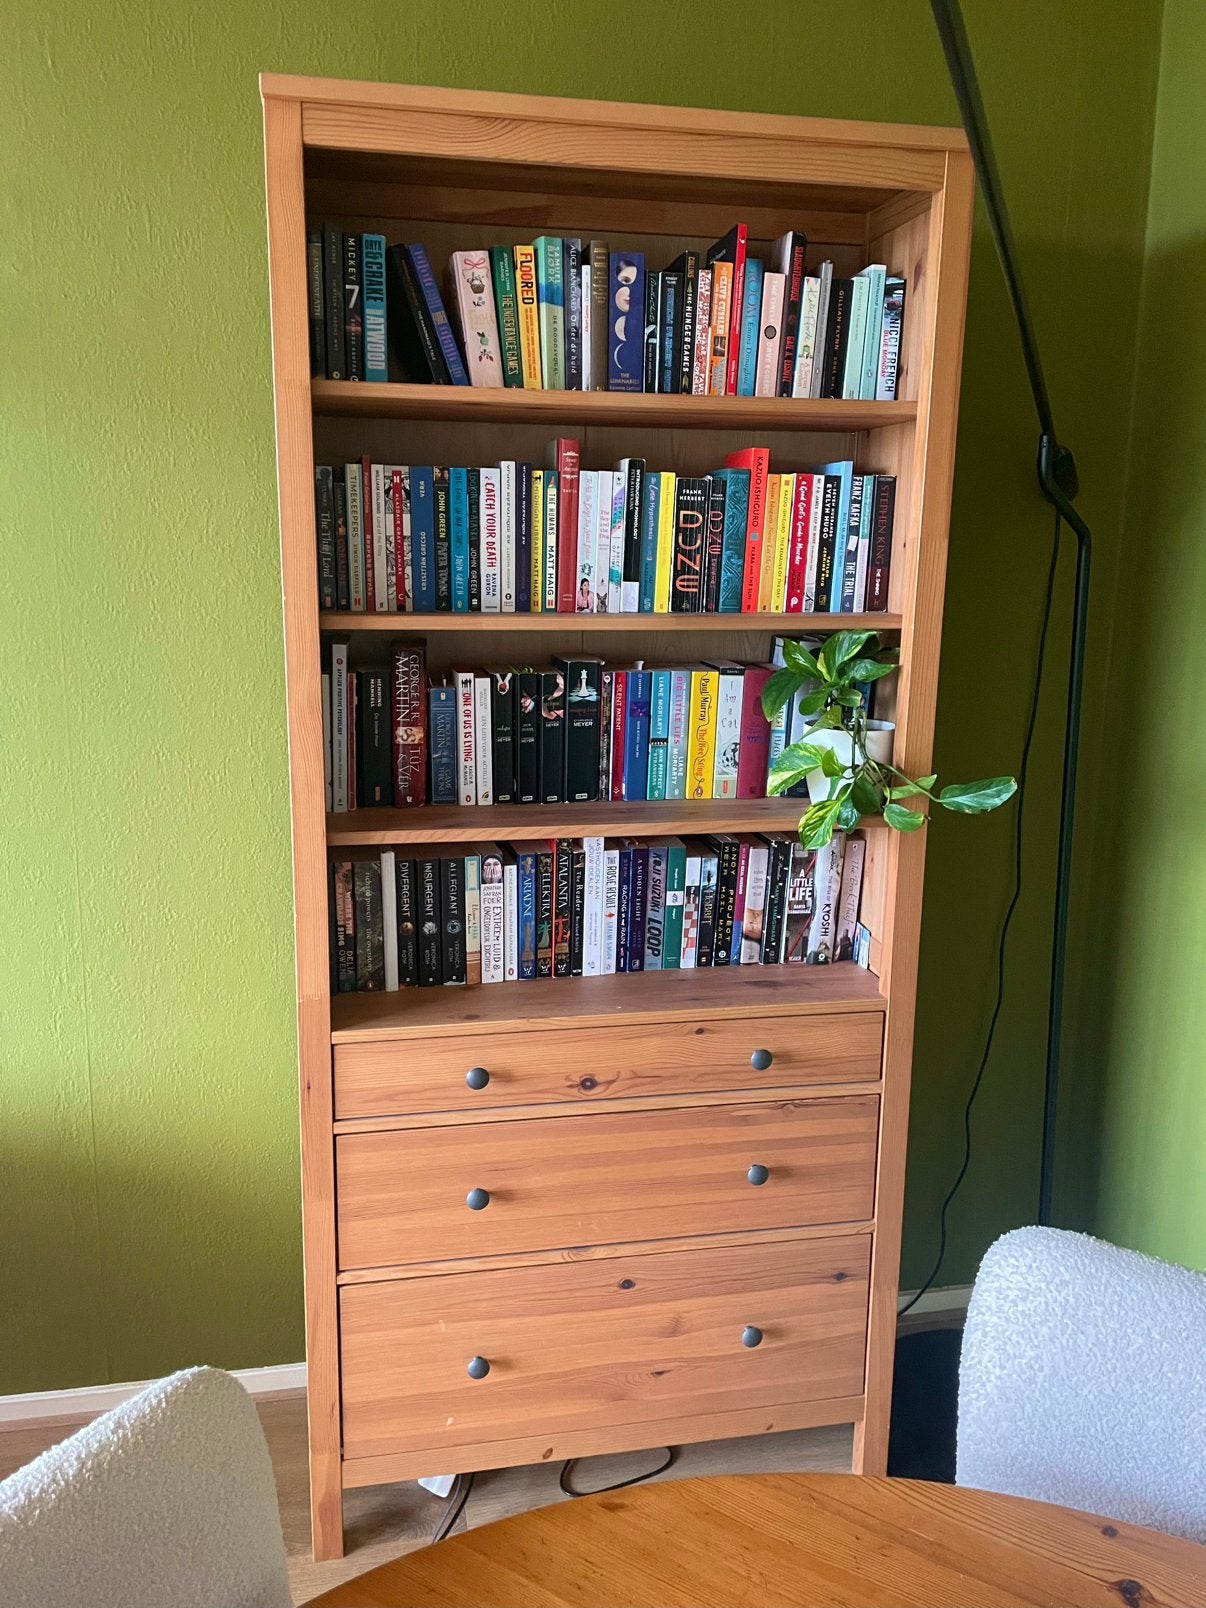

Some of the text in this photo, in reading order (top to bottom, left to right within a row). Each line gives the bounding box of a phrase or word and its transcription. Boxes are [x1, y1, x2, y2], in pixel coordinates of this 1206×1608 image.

[345, 238, 359, 309] MICKEY 7
[547, 245, 555, 283] BJØRK
[553, 246, 561, 284] SAMUEL
[569, 244, 577, 266] ALICE
[687, 256, 695, 278] COLLINS
[789, 245, 804, 303] SLAUGHTERHOUSE
[365, 261, 384, 302] CRAKE
[520, 252, 534, 305] FLOORED
[716, 276, 728, 335] CLIVE CUSSLER
[833, 289, 845, 351] GILLIAN FLYNN
[367, 316, 385, 370] ATWOOD
[502, 294, 519, 375] THE INHERITANCE GAMES
[570, 314, 578, 374] Onder de huid
[682, 306, 694, 373] HUNGER GAMES
[700, 332, 708, 356] MAAR
[747, 321, 755, 345] Emma
[784, 335, 794, 351] GAIL
[880, 329, 890, 378] BLUE MONDAY
[884, 318, 901, 393] NICCI FRENCH
[350, 475, 359, 538] TIMEKEEPERS
[394, 493, 402, 525] ALASDAIR
[632, 469, 641, 540] INTRODUCING PHONOLOGY
[752, 456, 764, 528] KAZUO ISHIGURO
[821, 483, 833, 540] EVELYN HUGO
[848, 476, 864, 527] FRANZ KAFKA
[437, 491, 446, 539] JOHN GREEN
[485, 482, 497, 569] CATCH YOUR DEATH
[547, 508, 555, 537] HUMANS
[647, 502, 656, 541] Hypothesis
[794, 486, 808, 567] Good Murder
[874, 484, 890, 566] STEPHEN KING
[320, 511, 333, 579] The Thief Lord
[532, 525, 540, 556] LIBRARY
[547, 545, 555, 568] MATT
[437, 541, 449, 597] PAPER TOWNS
[454, 555, 465, 596] JOHN GREEN
[470, 547, 479, 595] JOHN GREEN
[547, 572, 555, 597] HAIG
[843, 561, 857, 598] THE TRIAL
[873, 578, 881, 597] SHINING
[394, 655, 411, 723] MARTIN
[408, 655, 422, 710] GEORGE R.
[701, 677, 710, 695] Paul
[462, 692, 474, 763] ONE OF US IS LYING
[573, 721, 593, 729] MEYER
[614, 683, 623, 732] SILENT PATIENT
[656, 676, 665, 736] LIANE MORIARTY
[673, 676, 684, 746] BIG LITTLE LIES
[699, 696, 709, 723] Murray
[435, 713, 448, 749] MARTIN
[396, 753, 412, 791] & VÉR
[671, 748, 679, 786] MORIARTY
[364, 871, 372, 897] richard
[400, 862, 411, 918] DIVERGENT
[423, 862, 434, 918] INSURGENT
[448, 862, 459, 917] ALLEGIANT
[540, 872, 552, 919] ELEKTRA
[557, 853, 570, 910] ATALANTA
[574, 871, 584, 912] The Reader
[606, 864, 618, 886] ROSIE
[635, 864, 643, 897] SUDDEN
[789, 887, 813, 901] LIFE
[790, 878, 814, 887] LITTLE
[799, 868, 805, 879] A
[522, 876, 533, 918] ARIADNE
[619, 884, 629, 945] RACING RAIN
[646, 851, 663, 959] KOJI SUZUKI LOOP
[700, 889, 715, 927] HOBBIT
[337, 926, 345, 948] SING
[492, 906, 502, 941] EXTREEM
[820, 902, 832, 938] KYOSHI
[493, 943, 502, 963] LUID
